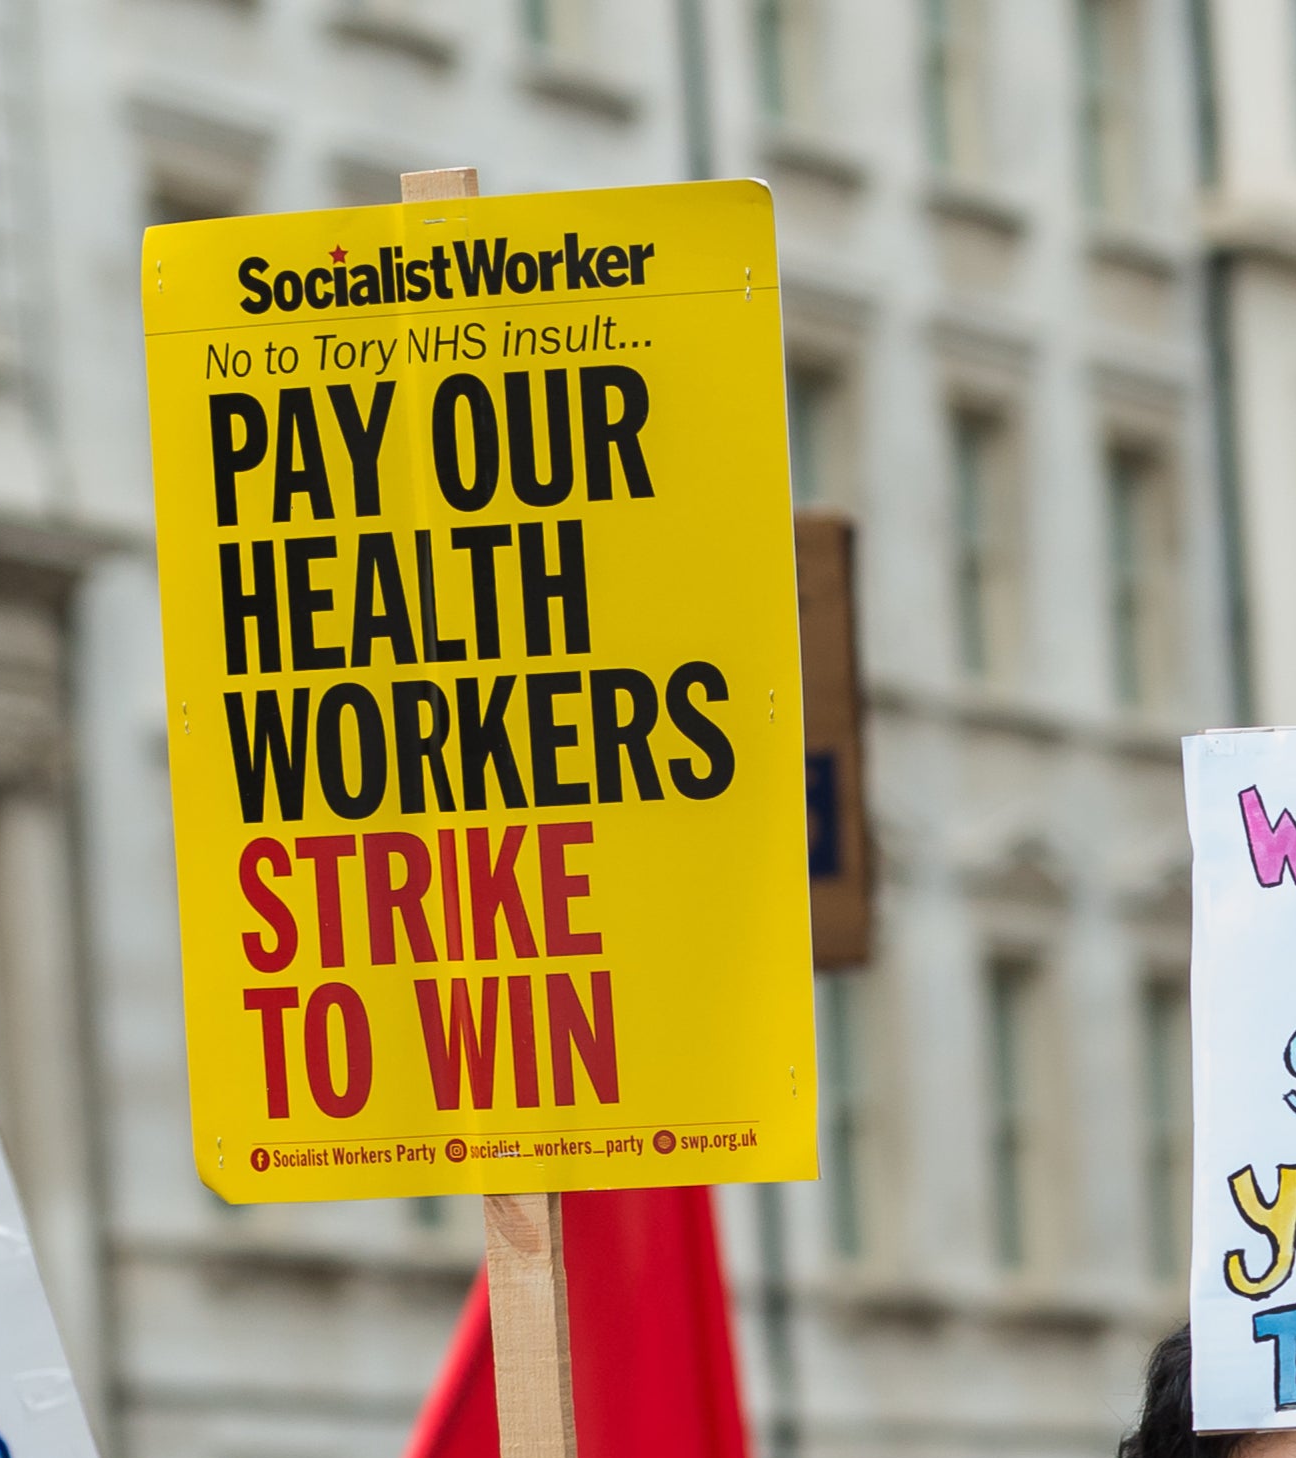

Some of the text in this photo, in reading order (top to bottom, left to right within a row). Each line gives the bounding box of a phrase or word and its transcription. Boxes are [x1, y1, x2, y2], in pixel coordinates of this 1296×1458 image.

[206, 315, 653, 380] No to Tory NHS insult...
[208, 364, 655, 526] PAY OUR
[218, 519, 591, 676] HEALTH
[224, 660, 736, 823] WORKERS
[238, 821, 603, 973] STRIKE
[243, 970, 620, 1119] TO WIN
[273, 1144, 436, 1168] Socialist Workers Party
[681, 1128, 757, 1152] swp.org.uk
